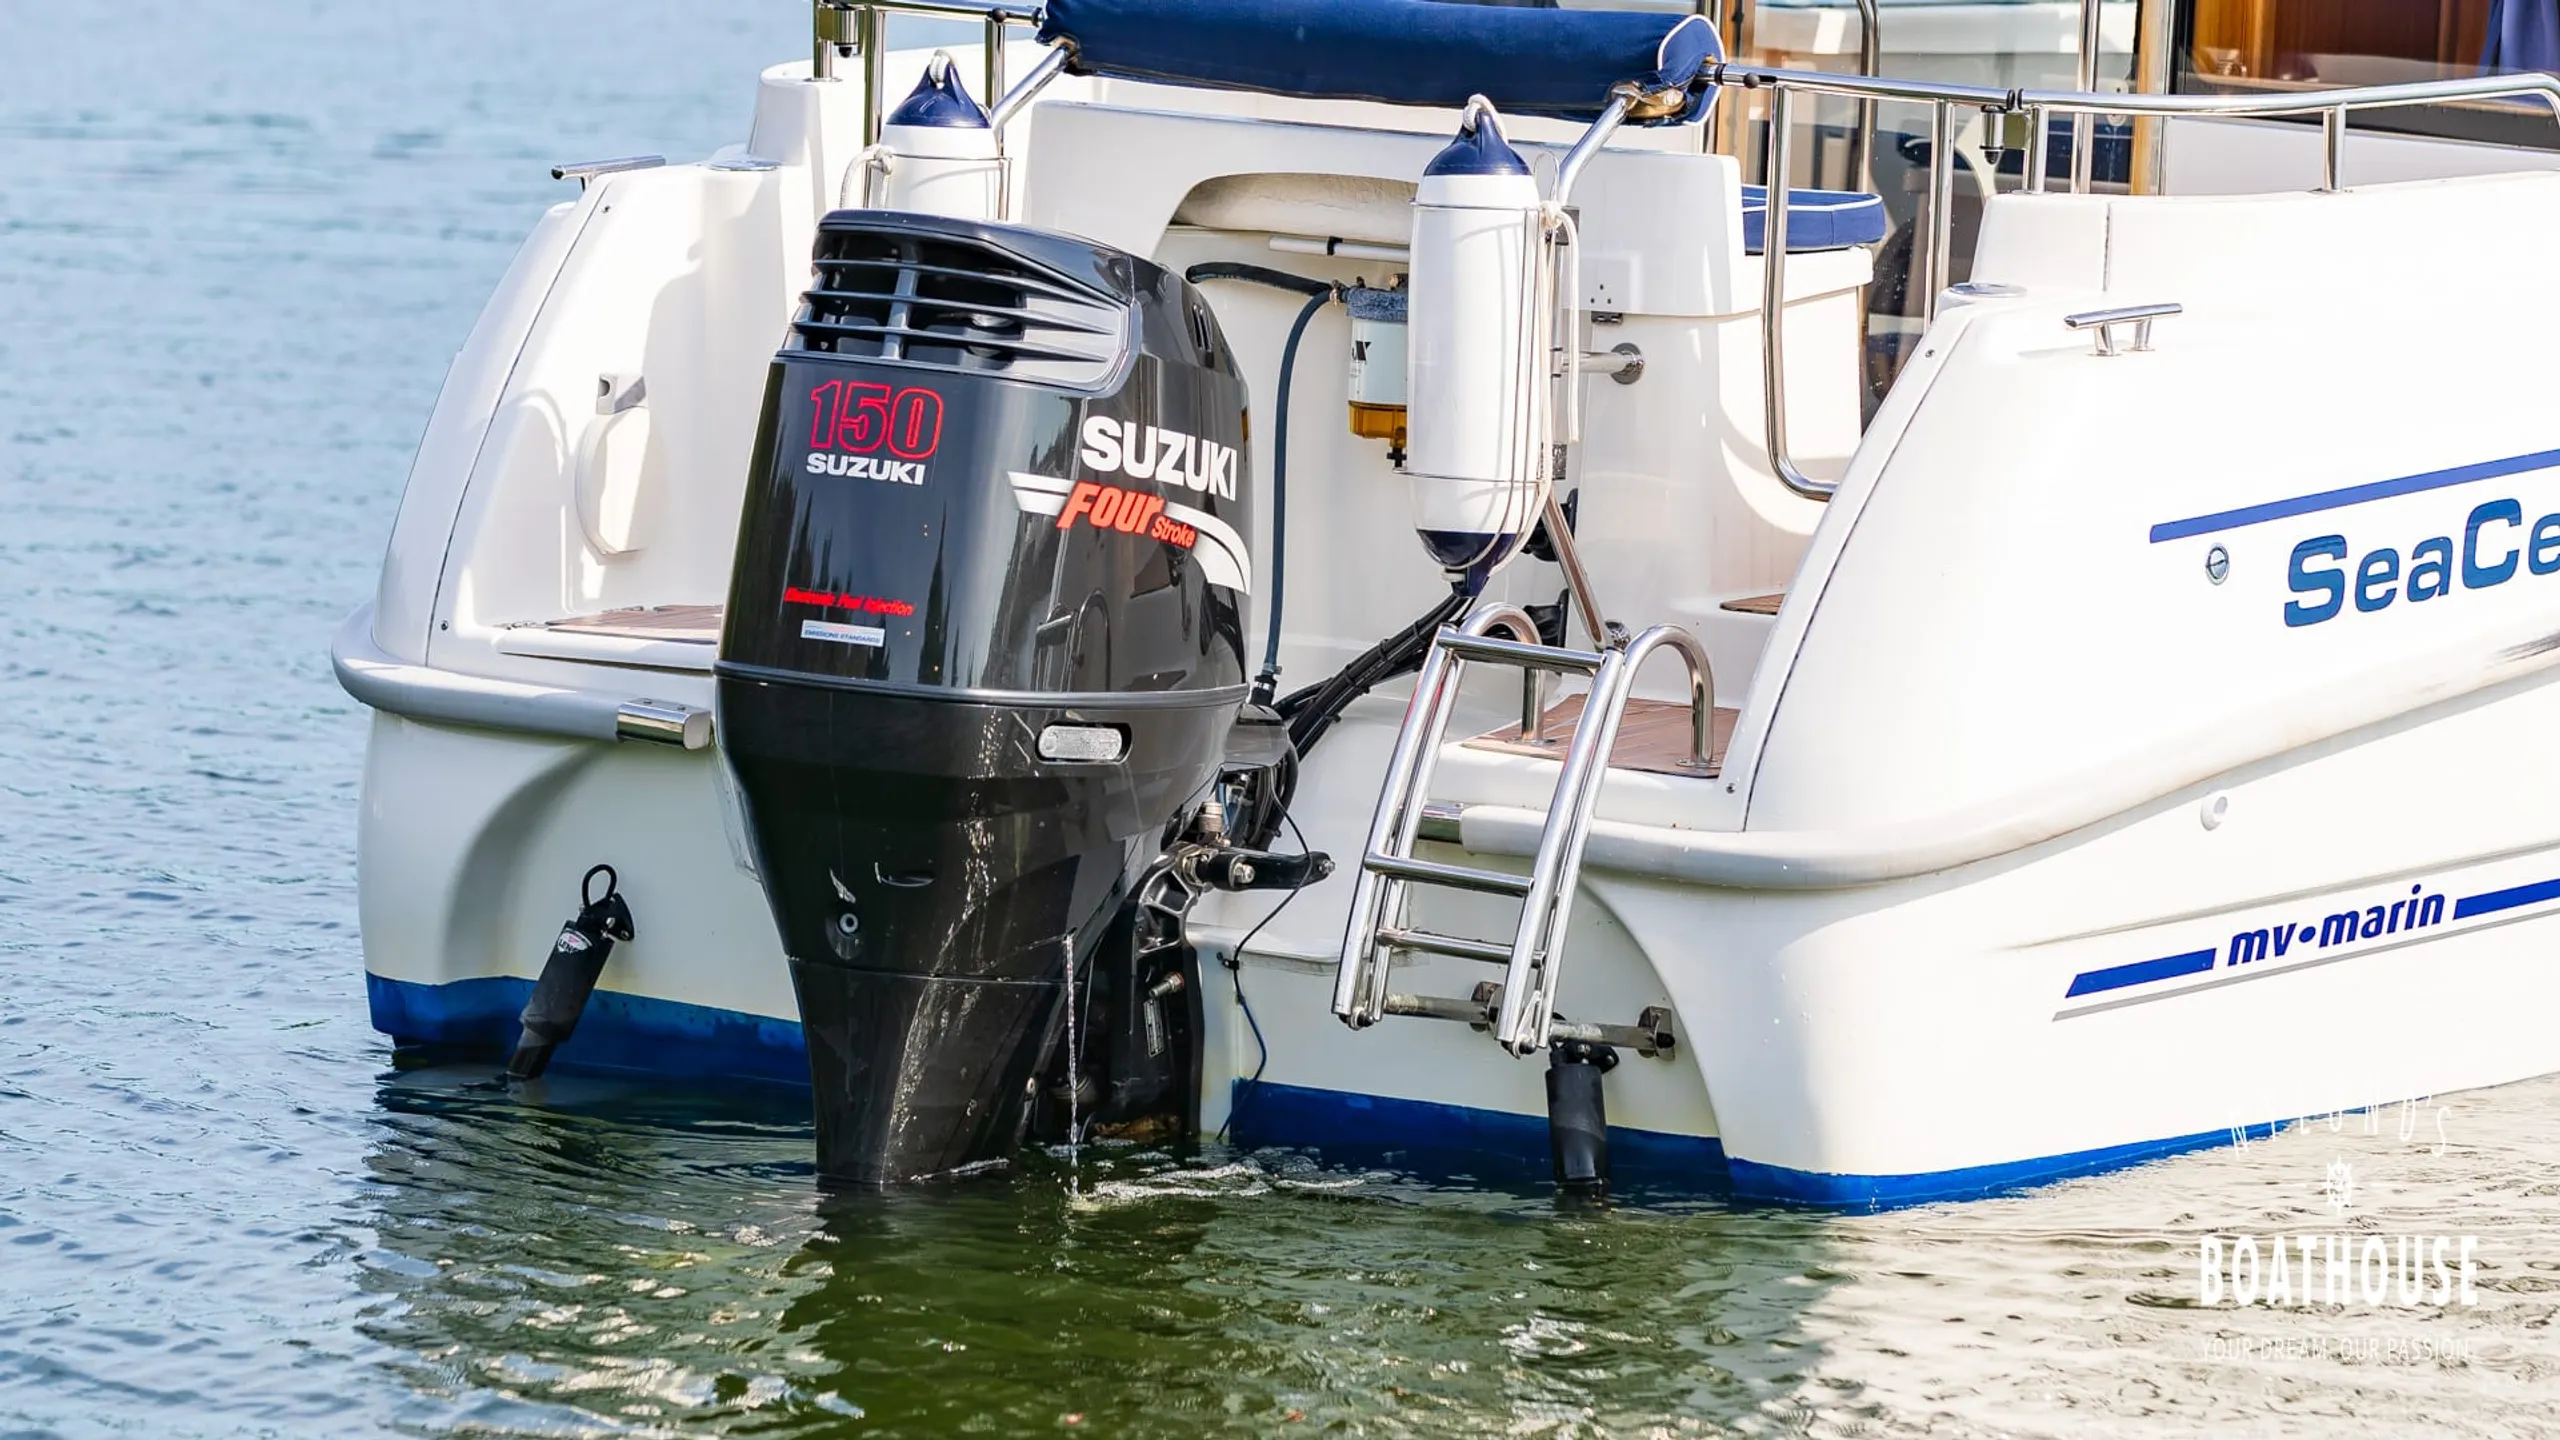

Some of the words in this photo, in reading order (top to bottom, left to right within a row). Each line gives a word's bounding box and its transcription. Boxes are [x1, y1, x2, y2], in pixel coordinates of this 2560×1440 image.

[810, 379, 944, 459] 150
[1081, 415, 1237, 502] SUZUKI
[806, 452, 926, 486] SUZUKI
[1150, 515, 1197, 548] Stroke
[2284, 498, 2560, 627] SeaCe
